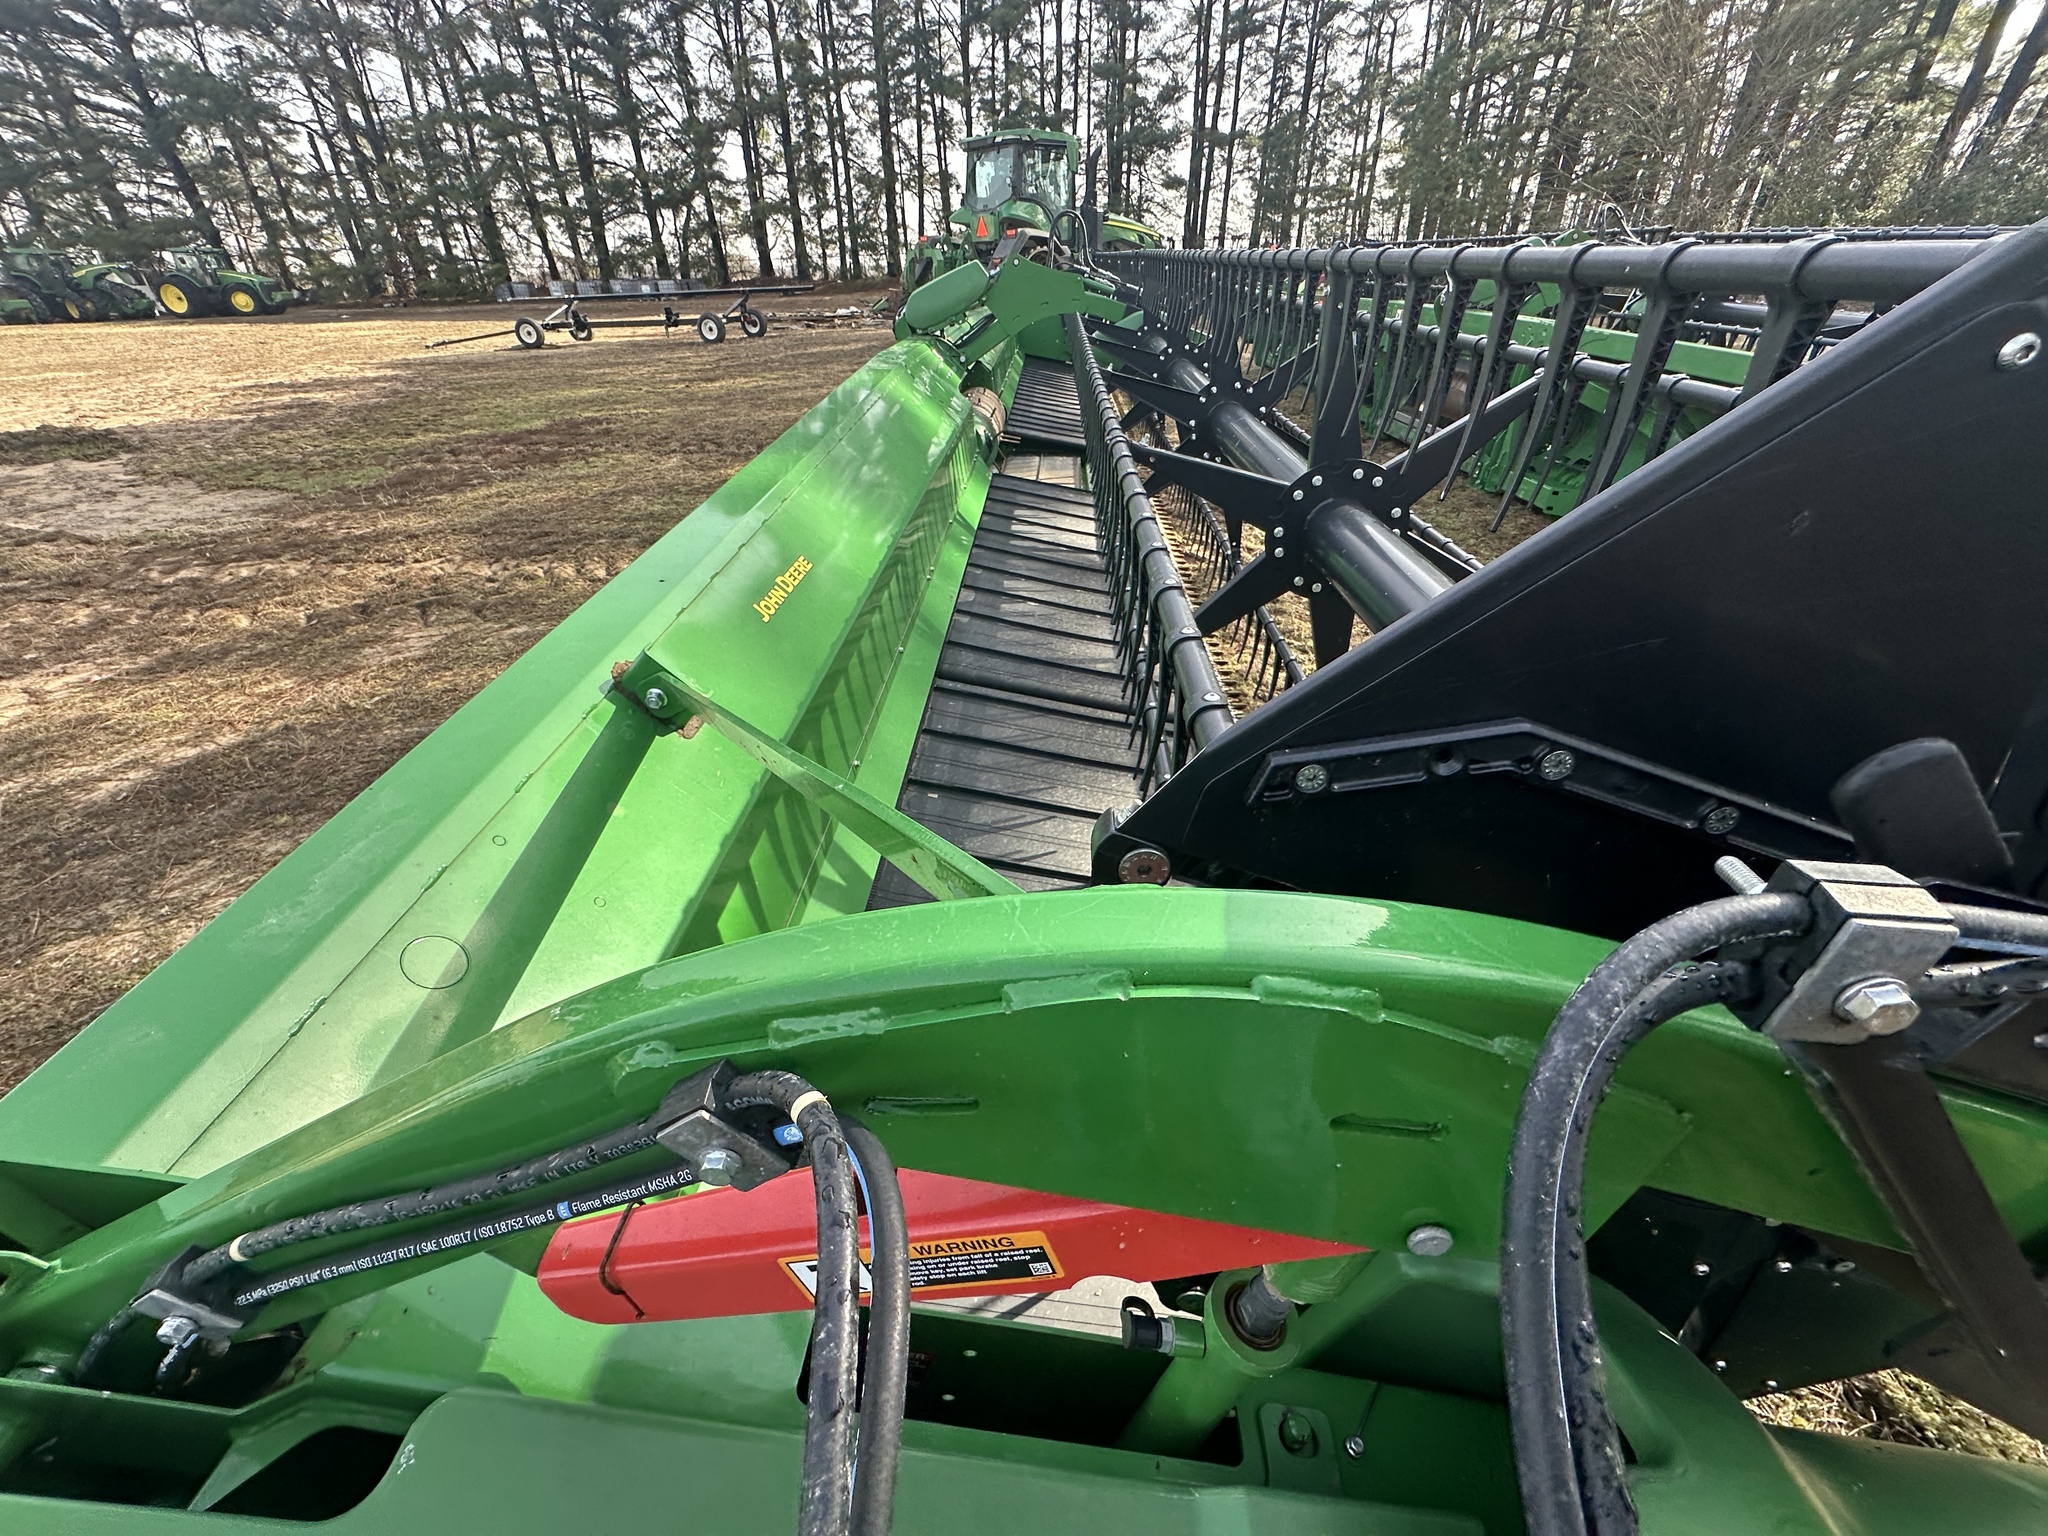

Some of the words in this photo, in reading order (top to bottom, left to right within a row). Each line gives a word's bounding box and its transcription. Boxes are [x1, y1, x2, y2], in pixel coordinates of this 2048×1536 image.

[752, 584, 788, 623] JOHN
[774, 555, 813, 594] DEERE
[372, 1249, 397, 1266] 11237
[398, 1245, 414, 1259] R17
[438, 1230, 471, 1249] 100R17
[494, 1217, 526, 1235] 18752
[524, 1213, 546, 1227] Type
[571, 1199, 601, 1214] Flame
[601, 1184, 649, 1206] Resistant
[647, 1173, 679, 1193] MSHA
[677, 1168, 693, 1184] 2G
[911, 1236, 1015, 1256] WARNING
[922, 1256, 951, 1265] injuries
[951, 1254, 970, 1262] from
[958, 1264, 976, 1272] park
[976, 1262, 998, 1270] brake
[970, 1257, 994, 1265] raised
